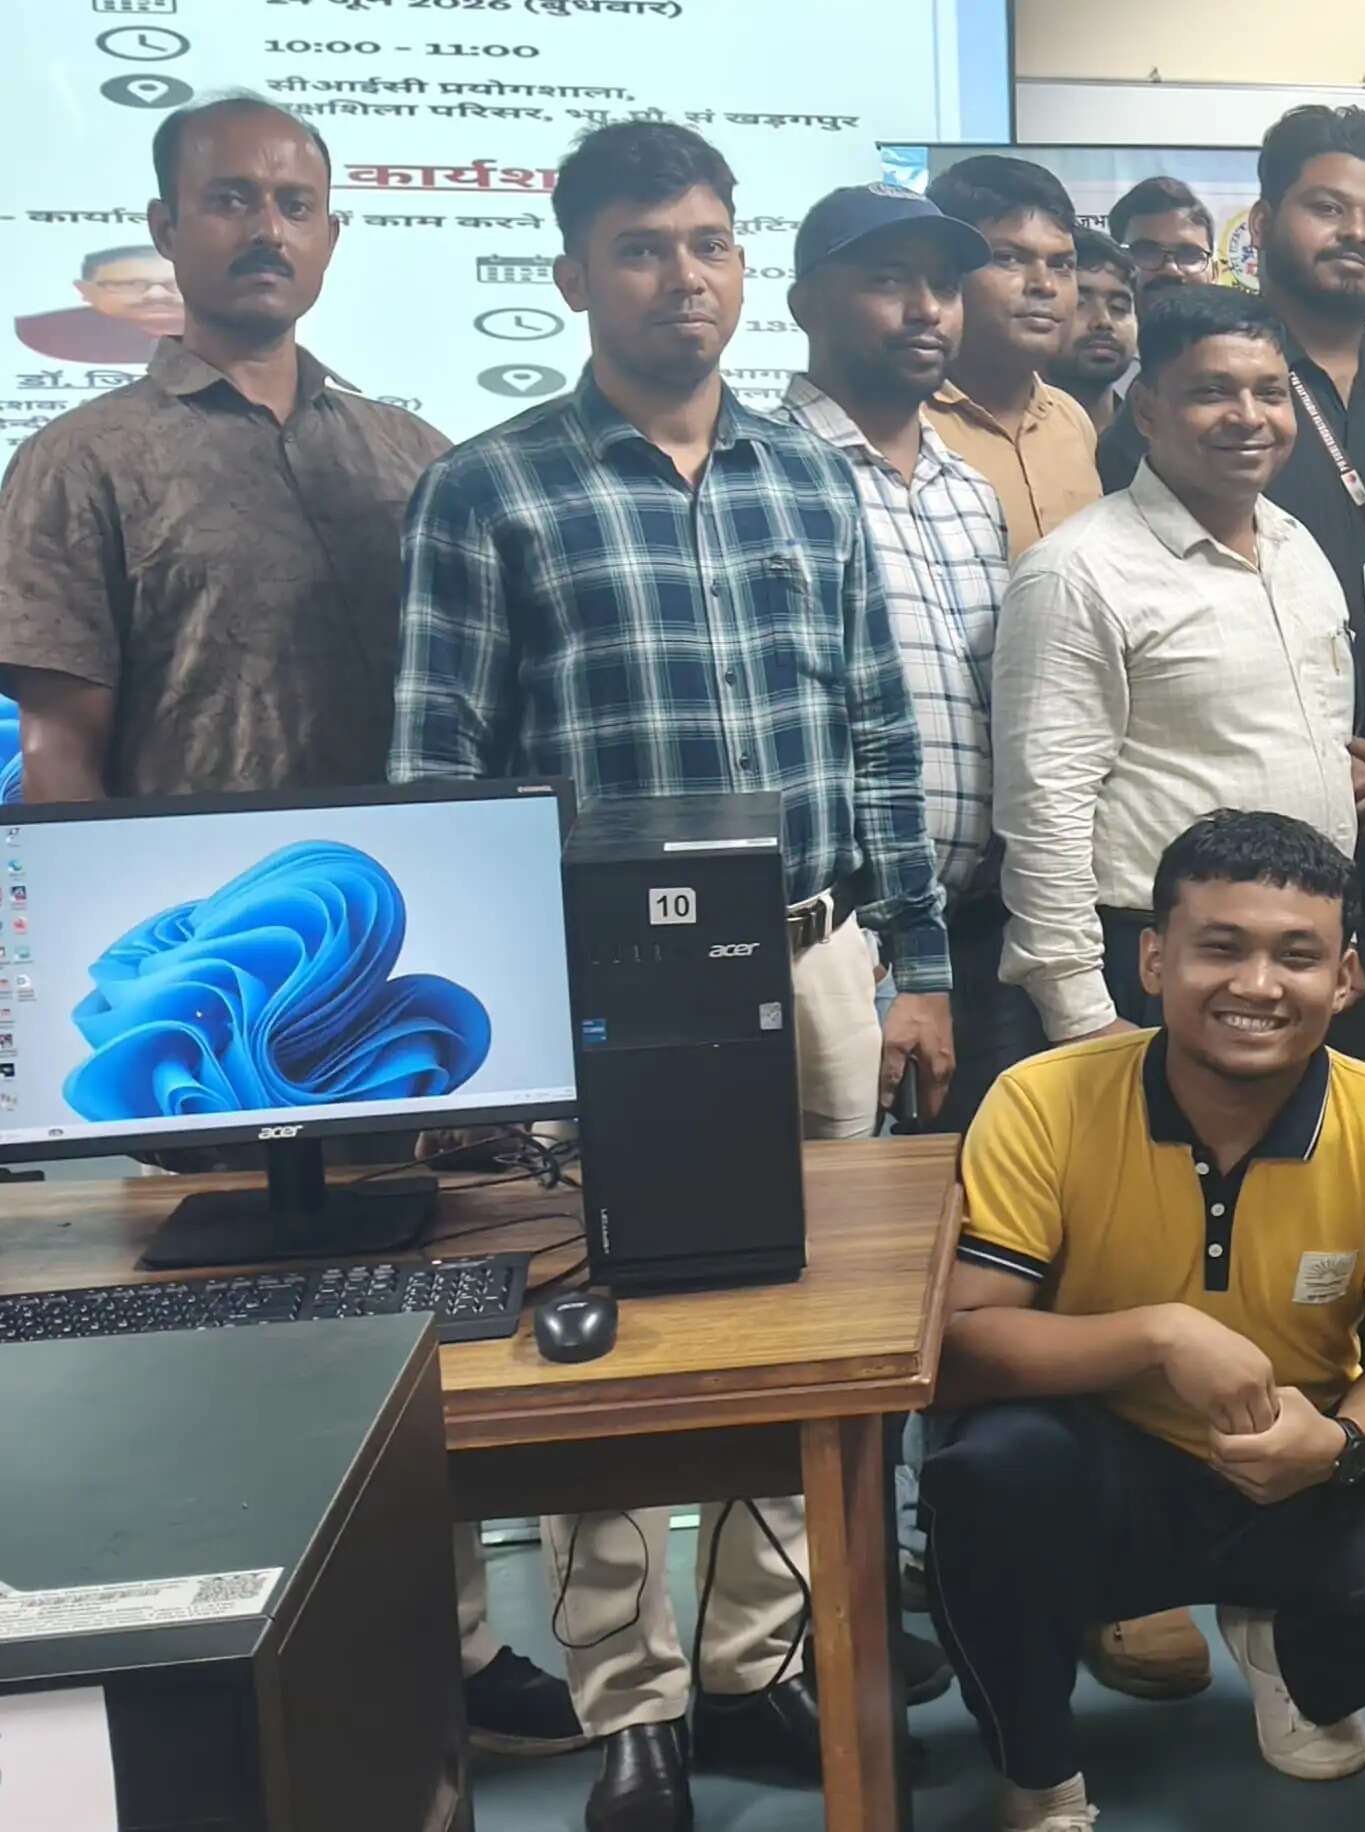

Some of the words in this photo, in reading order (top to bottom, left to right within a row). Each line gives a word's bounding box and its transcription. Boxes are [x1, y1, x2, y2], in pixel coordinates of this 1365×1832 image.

[264, 39, 381, 54] 10:00
[425, 42, 540, 58] 11:00
[266, 77, 428, 95] सीआईसी
[439, 79, 635, 101] प्रयोगशाला,
[363, 213, 444, 229] काम
[456, 211, 544, 230] करने
[656, 895, 690, 917] 10
[709, 942, 760, 958] acer
[258, 1124, 303, 1140] acer
